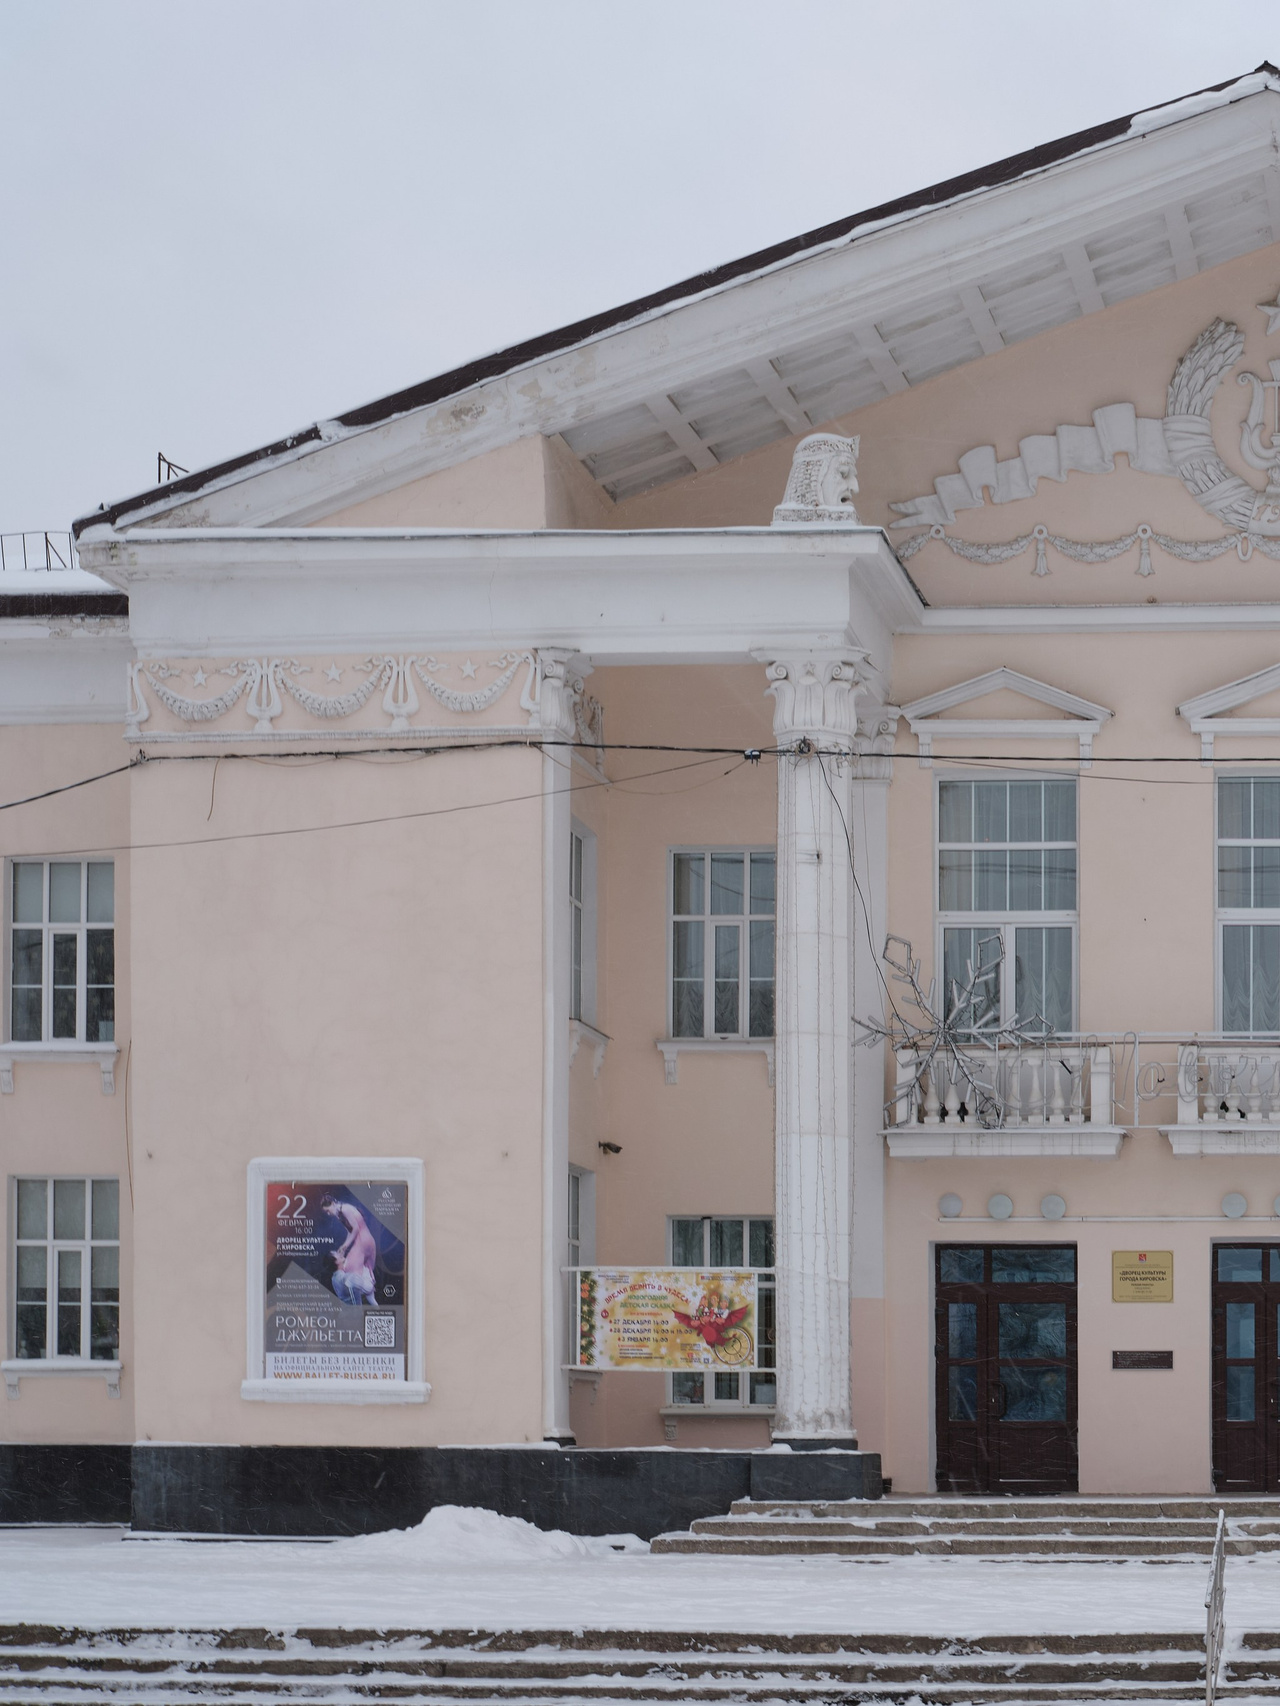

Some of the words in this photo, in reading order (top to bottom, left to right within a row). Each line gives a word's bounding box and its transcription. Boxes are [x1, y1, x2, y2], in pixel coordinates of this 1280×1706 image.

[277, 1194, 307, 1219] 22
[278, 1219, 314, 1227] ФЕВРАЛЯ
[629, 1283, 655, 1291] ВЕРИТЬ
[276, 1316, 328, 1328] РОМЕО
[276, 1329, 363, 1342] ДЖУЛЬЕТТА
[274, 1356, 317, 1364] БИЛЕТЫ
[321, 1356, 339, 1364] БЕЗ
[343, 1356, 395, 1365] НАЦЕНКИ
